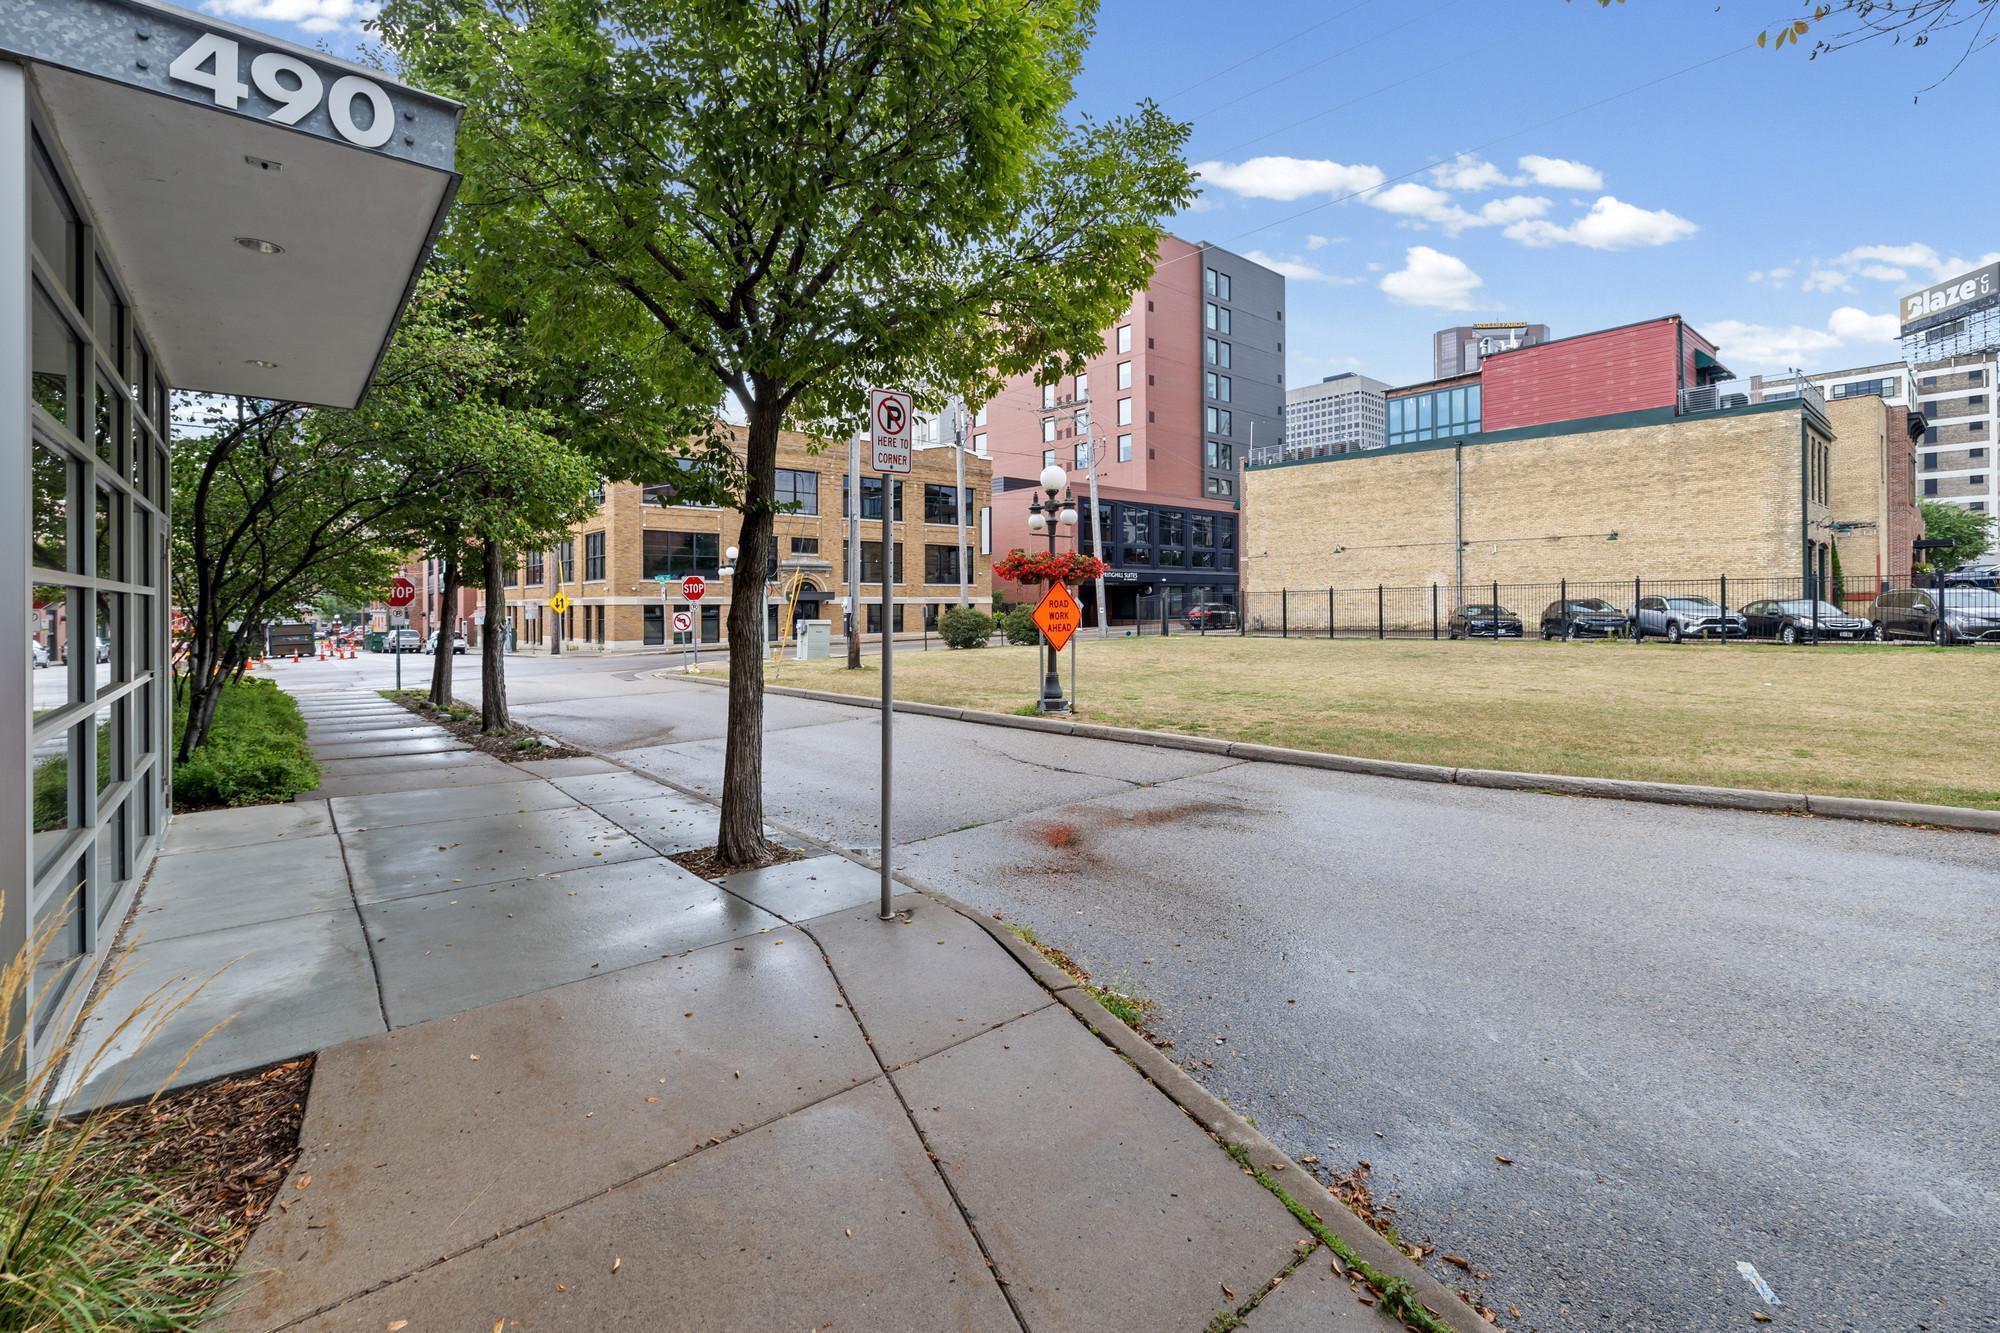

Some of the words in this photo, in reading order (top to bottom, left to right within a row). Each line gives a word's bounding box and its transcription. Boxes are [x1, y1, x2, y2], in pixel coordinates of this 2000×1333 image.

[169, 32, 395, 148] 490
[1907, 279, 1977, 320] Blaze
[877, 435, 897, 448] HERE
[900, 438, 909, 450] TO
[878, 453, 907, 465] CORNER
[683, 583, 704, 594] STOP
[1048, 599, 1069, 608] ROAD
[1048, 611, 1069, 621] WORK
[1047, 623, 1072, 633] AHEAD
